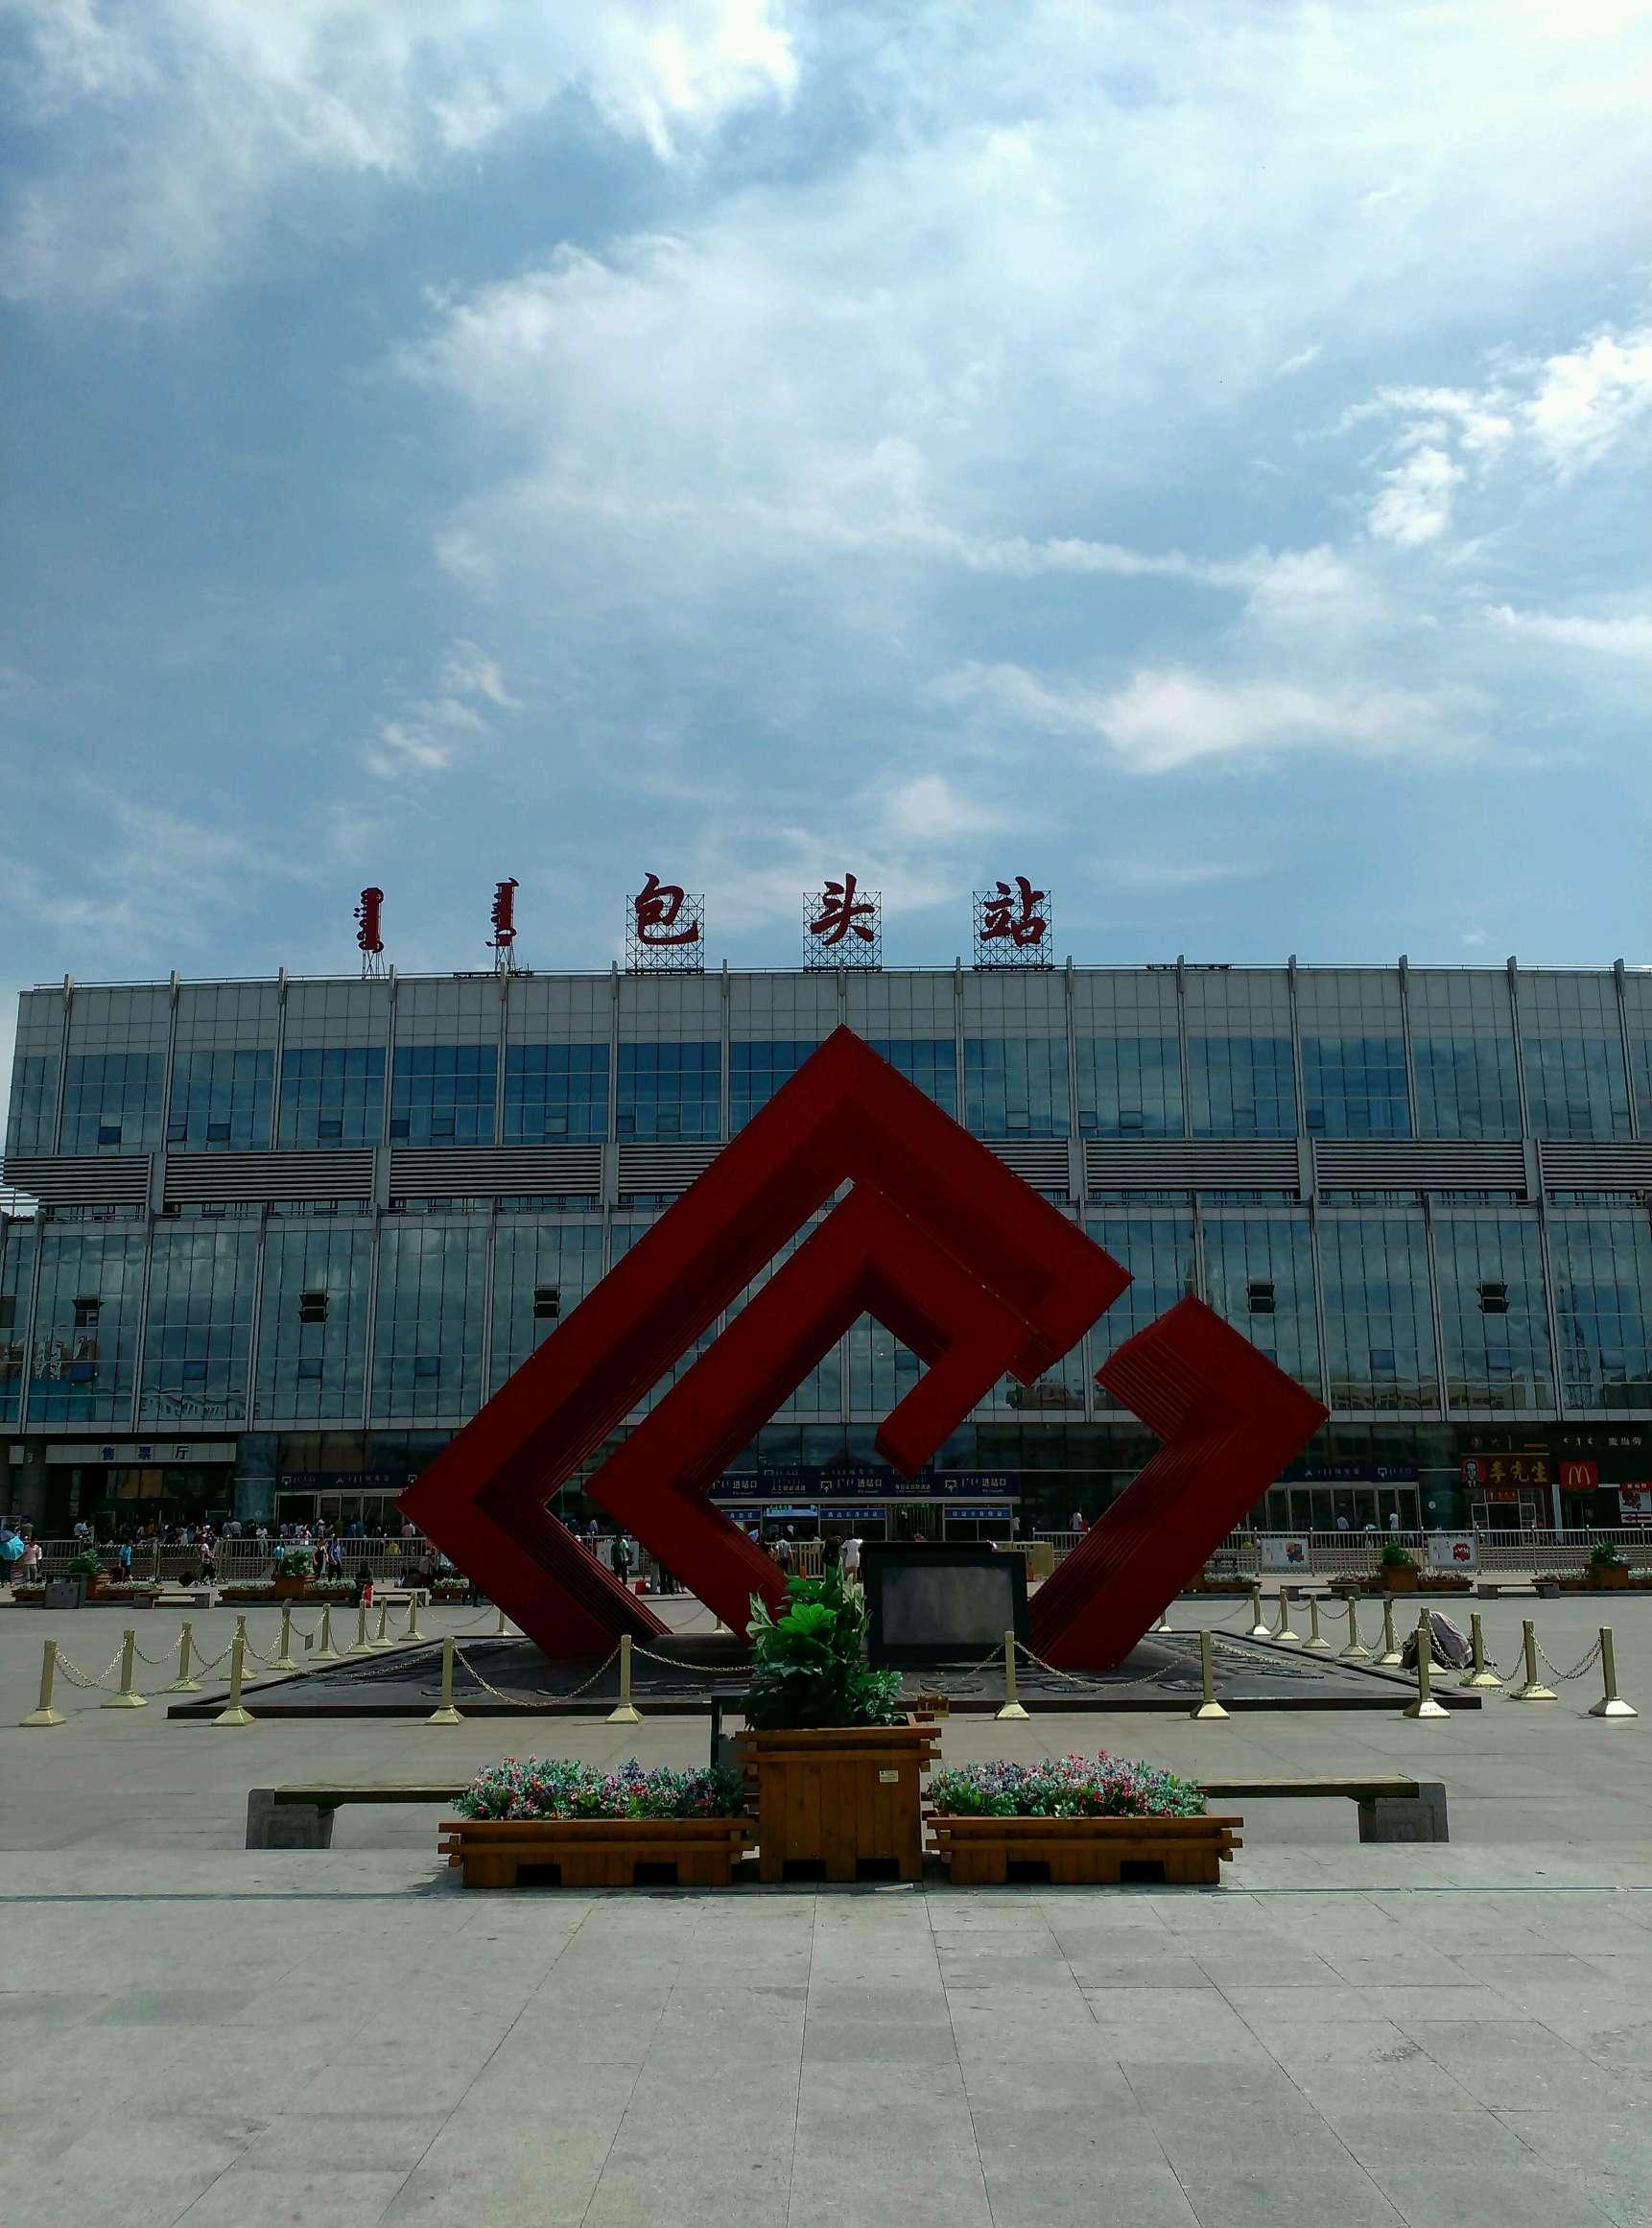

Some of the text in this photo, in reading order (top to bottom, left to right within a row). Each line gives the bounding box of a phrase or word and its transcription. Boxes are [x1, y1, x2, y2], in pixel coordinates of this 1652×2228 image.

[635, 872, 1047, 948] 包头站
[102, 1447, 189, 1460] 售票厅
[1489, 1459, 1547, 1483] 李先生
[733, 1480, 758, 1490] 进站口
